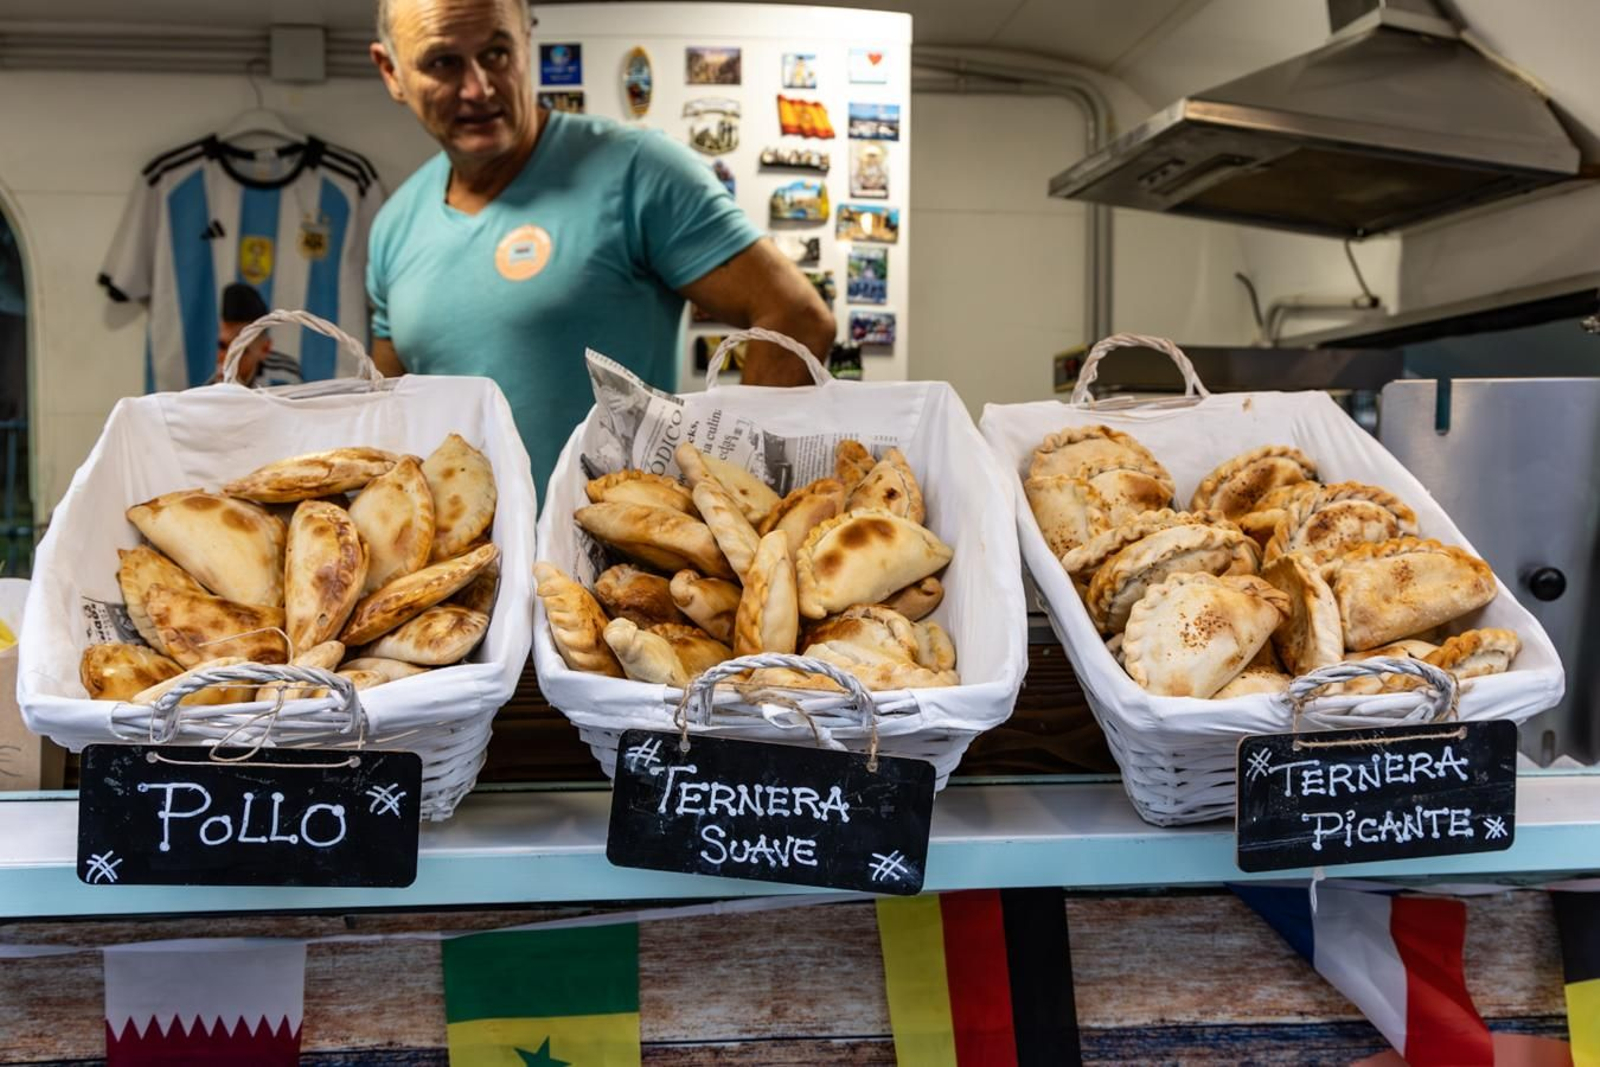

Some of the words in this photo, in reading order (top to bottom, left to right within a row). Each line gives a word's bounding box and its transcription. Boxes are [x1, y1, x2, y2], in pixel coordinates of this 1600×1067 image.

[646, 410, 682, 476] ÓDICO
[649, 764, 850, 823] TERNERA
[1268, 745, 1469, 797] TERNERA
[700, 824, 818, 867] SUAVE
